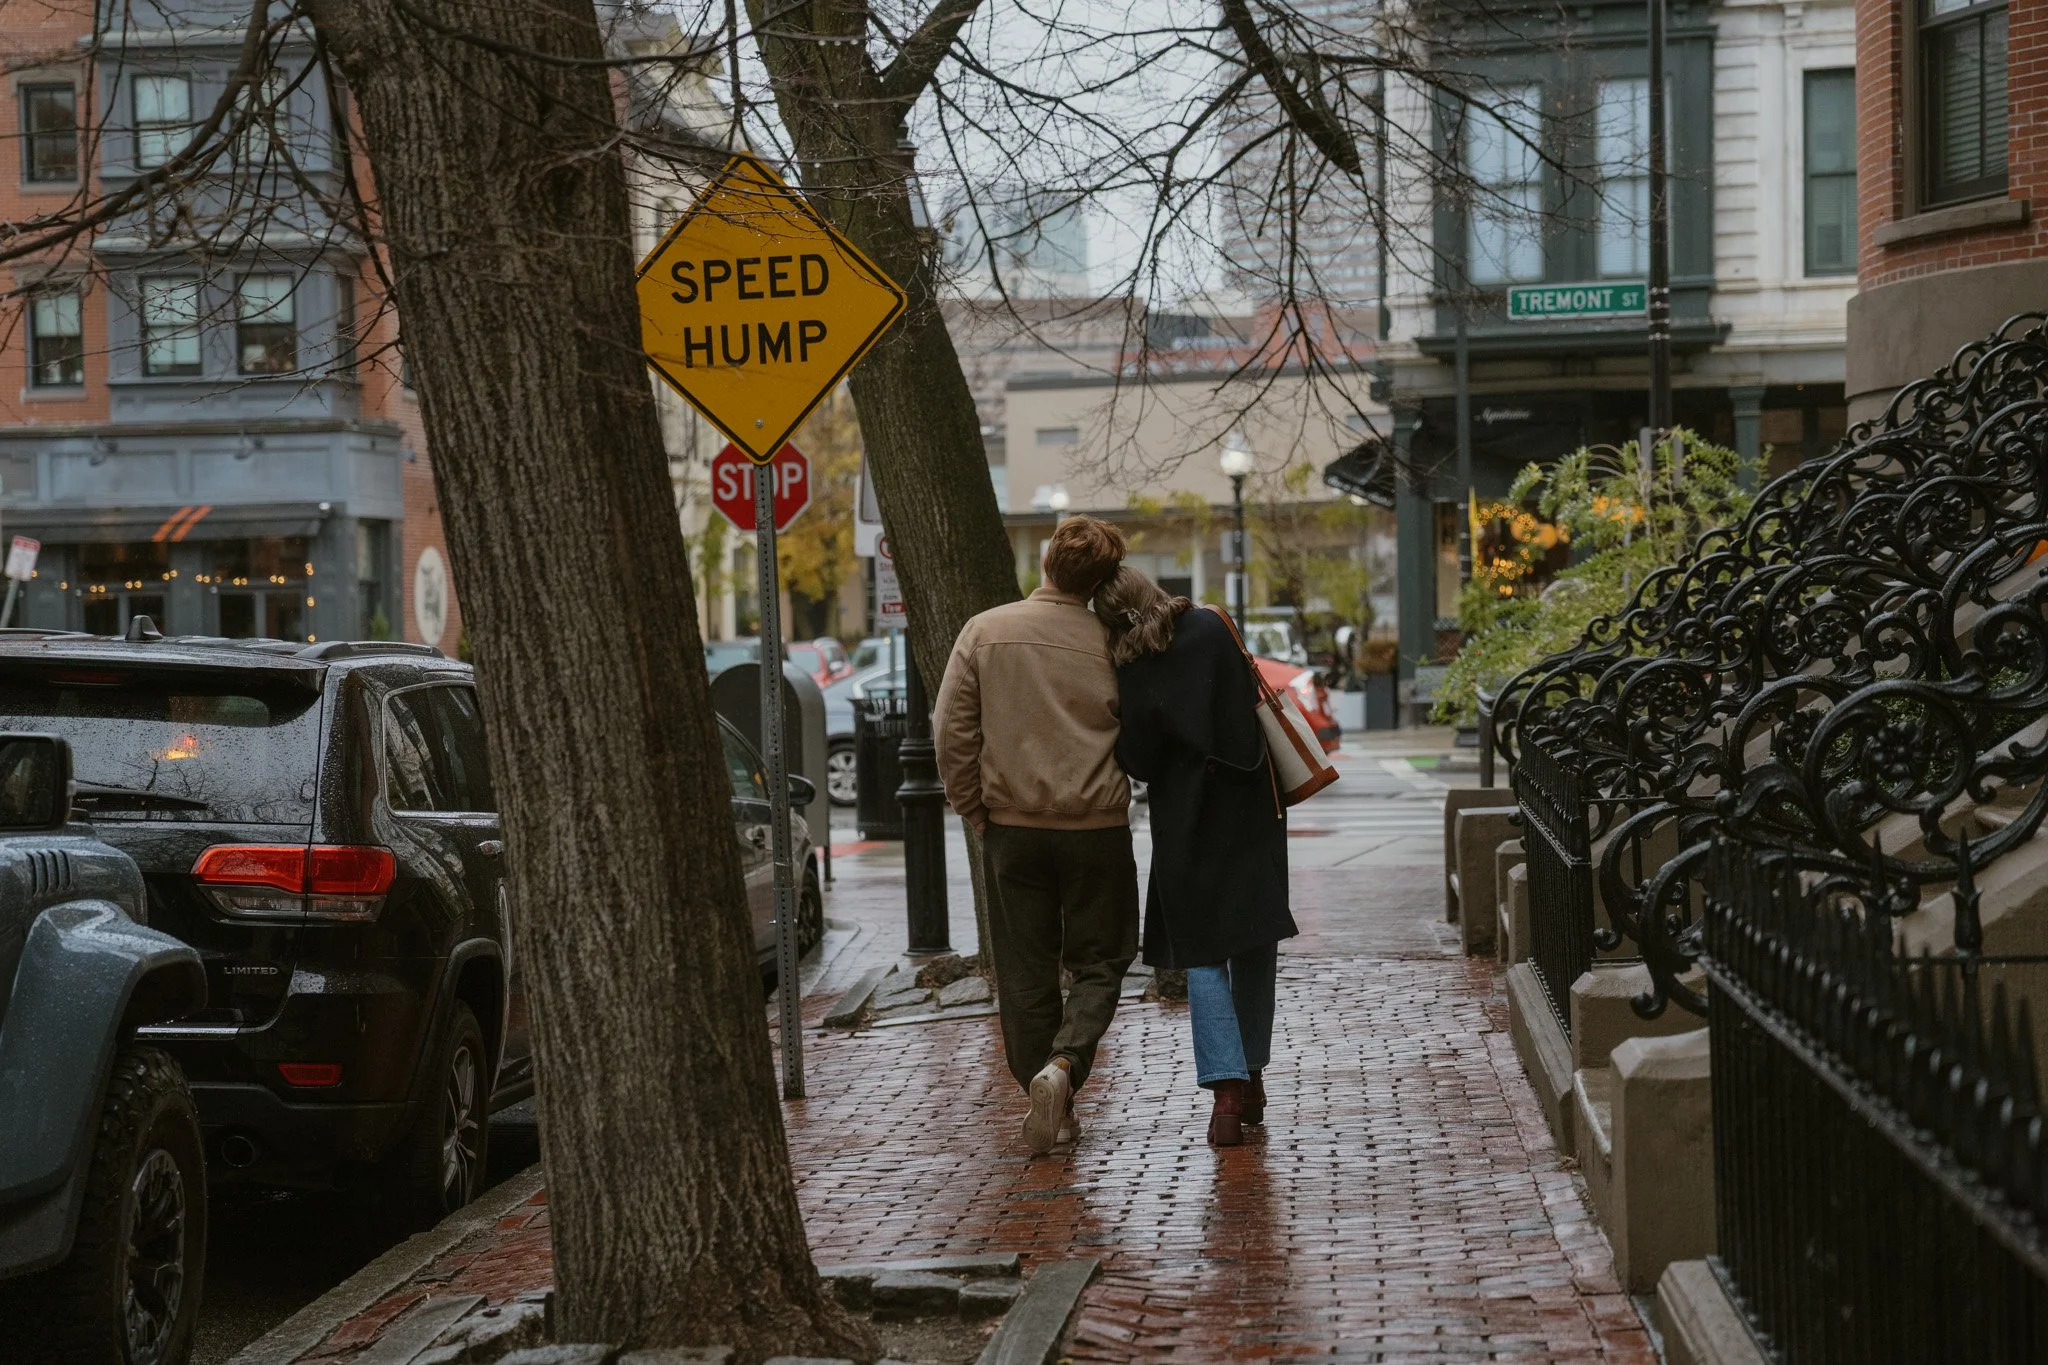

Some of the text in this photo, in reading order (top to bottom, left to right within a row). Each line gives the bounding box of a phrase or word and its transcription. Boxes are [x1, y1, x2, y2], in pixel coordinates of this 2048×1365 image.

[671, 254, 829, 304] SPEED
[1518, 290, 1639, 311] TREMONT ST
[684, 320, 828, 369] HUMP
[717, 462, 803, 501] STP
[224, 967, 278, 975] LIMITED
